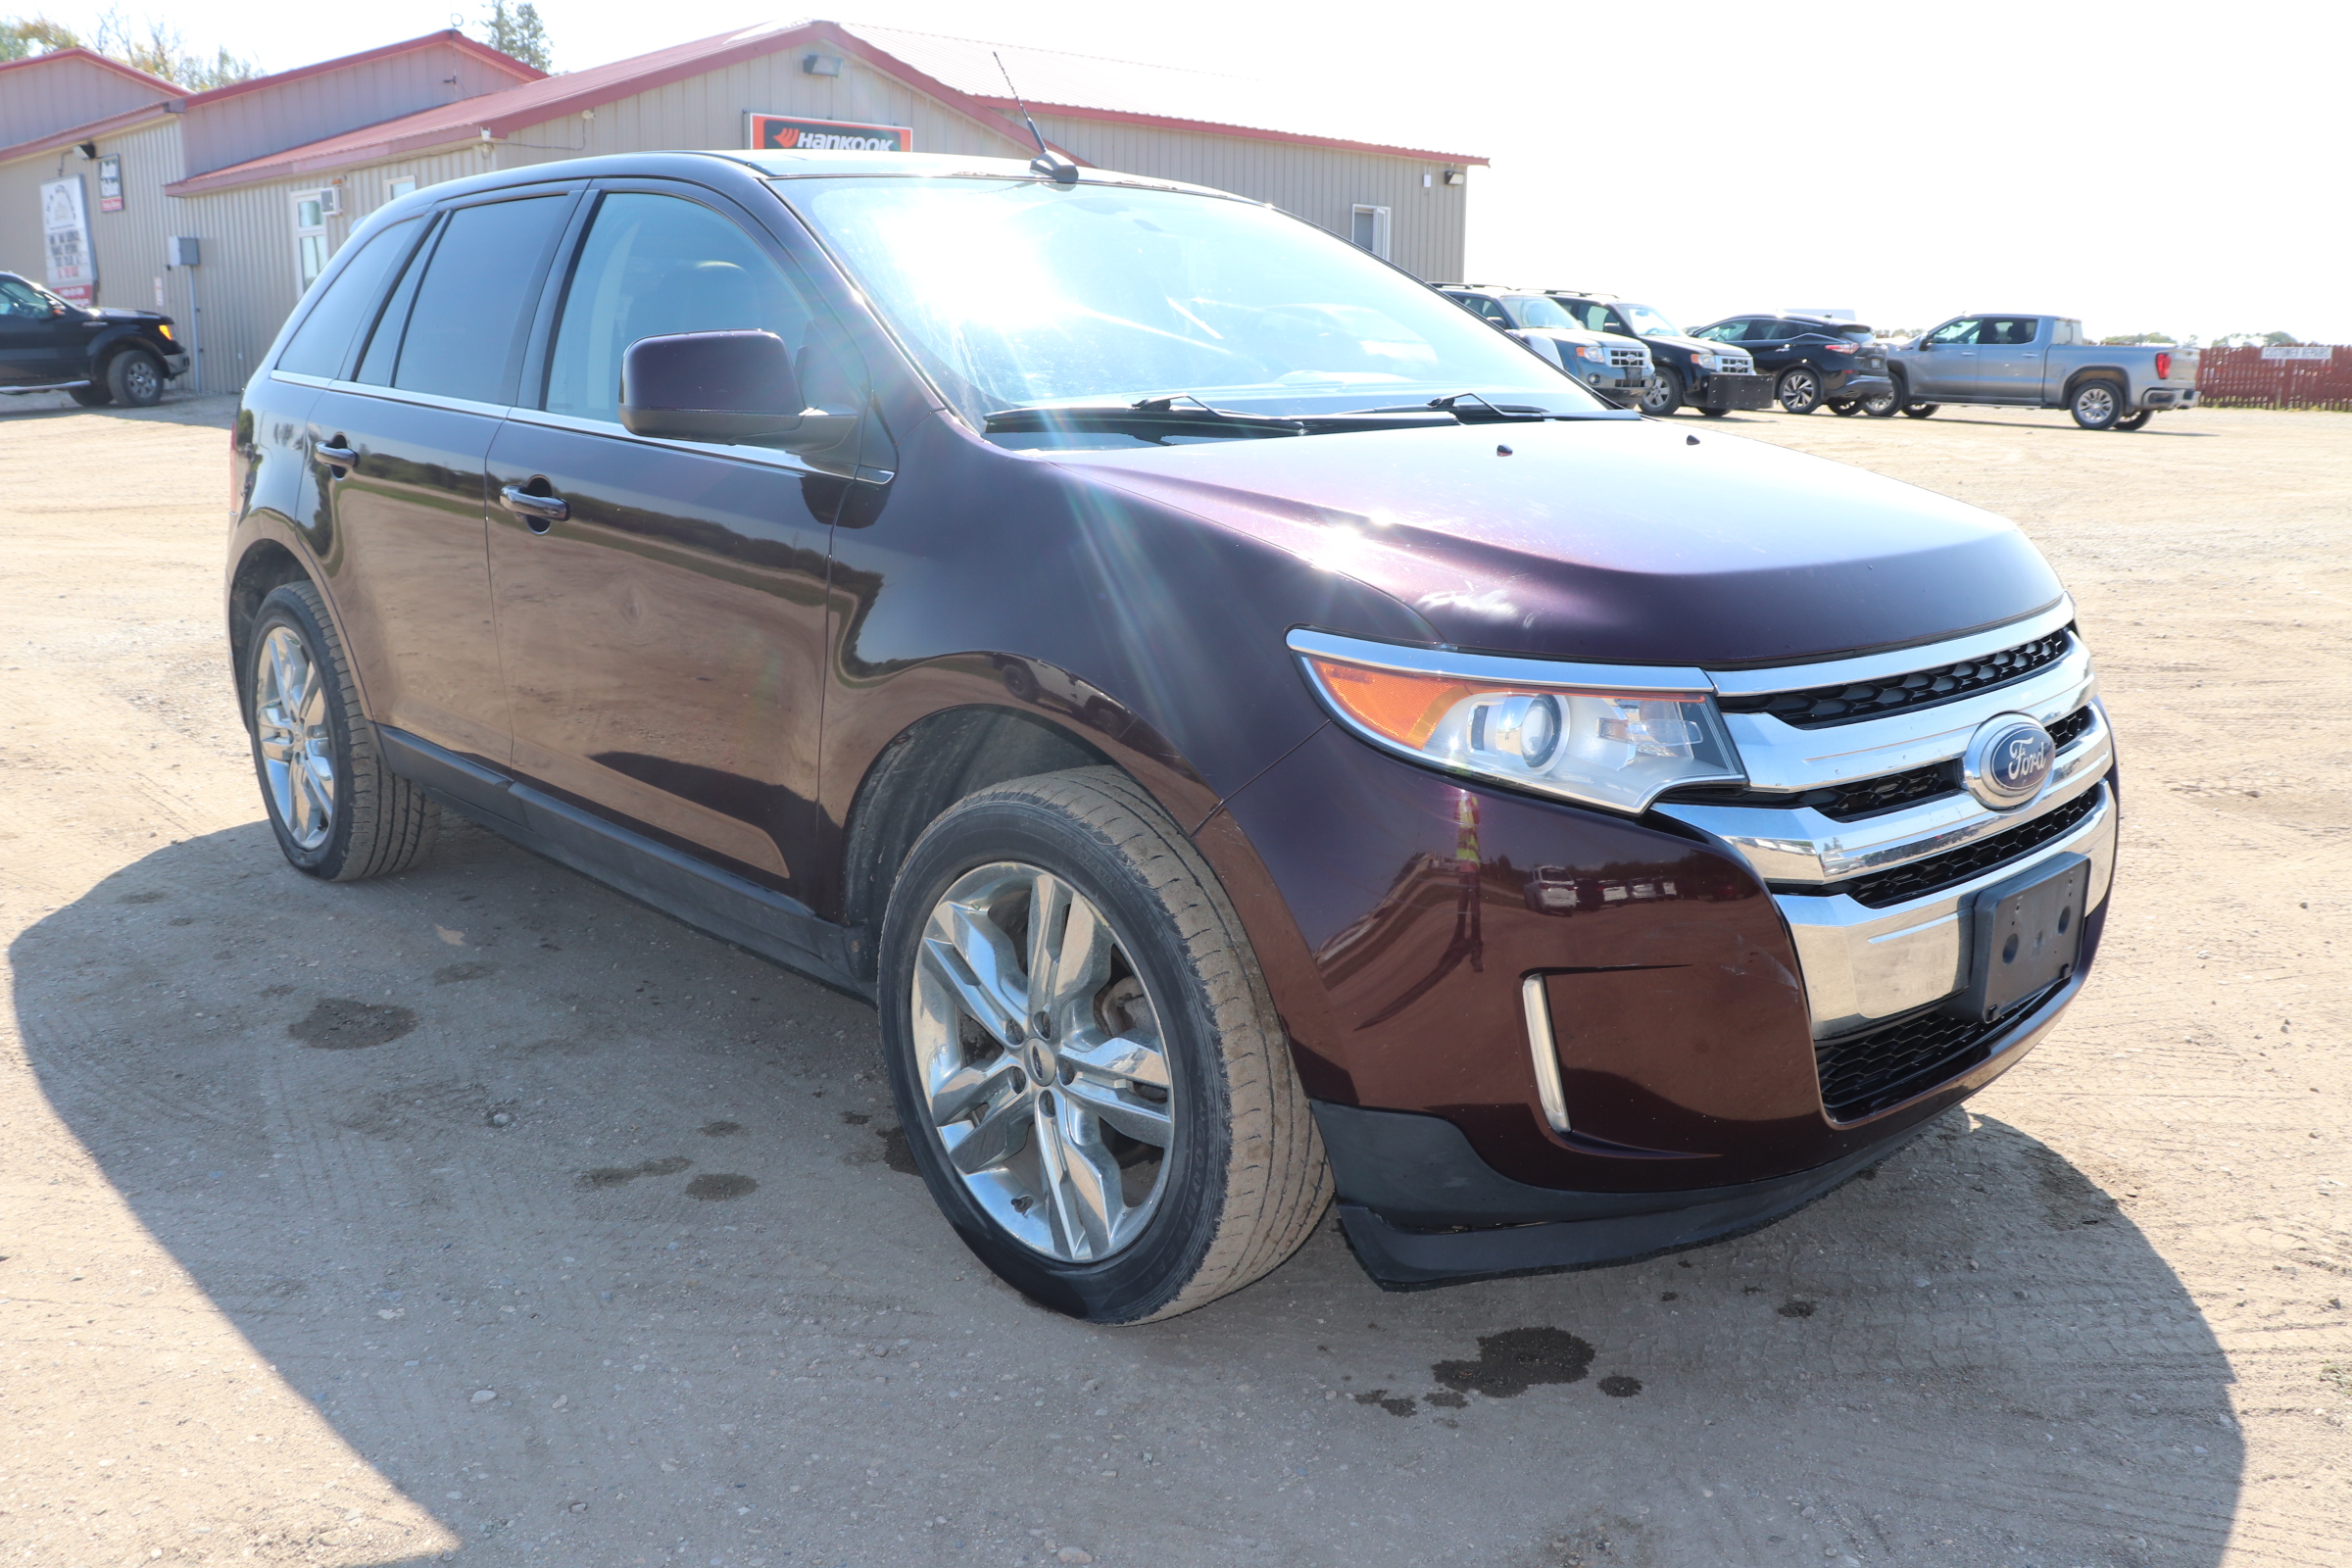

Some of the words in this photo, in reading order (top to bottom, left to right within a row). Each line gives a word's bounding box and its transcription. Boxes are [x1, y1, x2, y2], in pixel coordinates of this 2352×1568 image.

[2265, 347, 2300, 358] CUSTOMER
[2008, 737, 2046, 780] Ford
[1144, 1119, 1205, 1287] GOODYEAR
